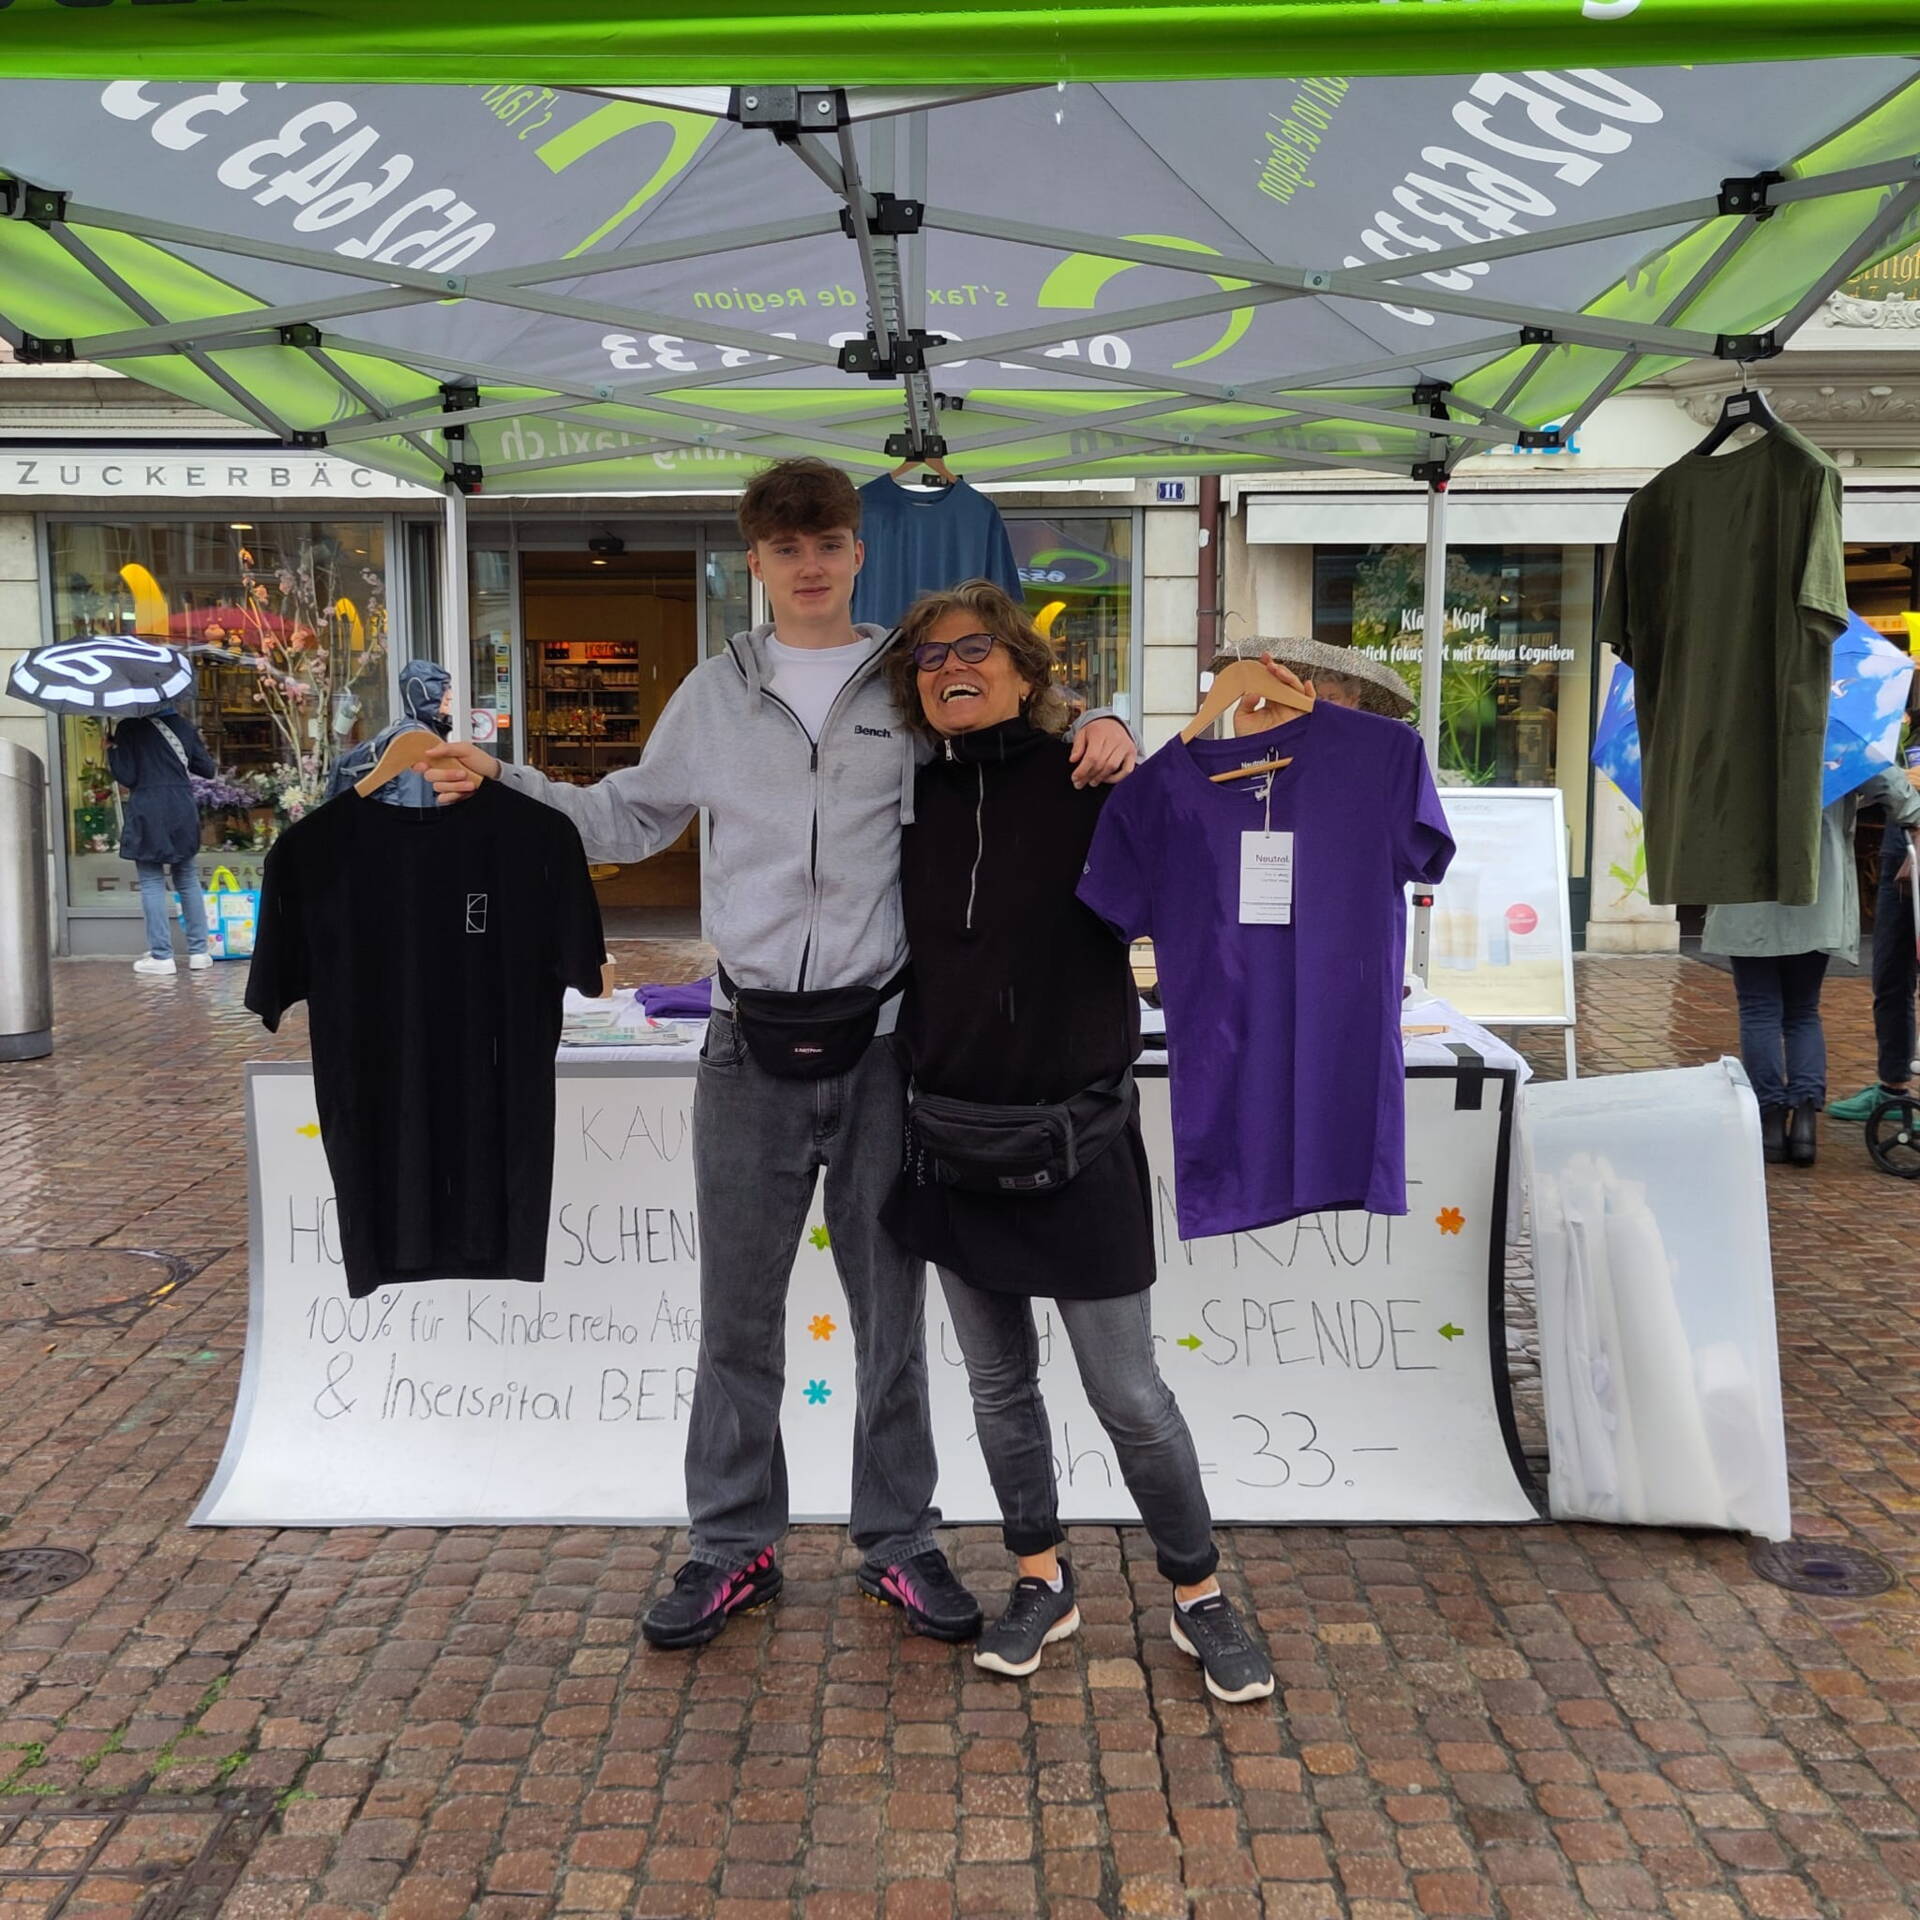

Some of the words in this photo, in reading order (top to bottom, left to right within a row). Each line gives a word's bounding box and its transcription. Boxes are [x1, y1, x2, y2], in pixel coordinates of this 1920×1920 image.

[1164, 483, 1177, 499] 11
[1452, 605, 1488, 634] Kopf
[1452, 644, 1474, 662] mit
[1476, 645, 1516, 662] Padma
[581, 1104, 694, 1162] KAU
[558, 1202, 697, 1266] SCHEN
[306, 1289, 404, 1344] 100%
[410, 1299, 444, 1343] für
[1202, 1298, 1438, 1370] SPENDE
[313, 1351, 358, 1420] &
[381, 1352, 573, 1422] Inselspital
